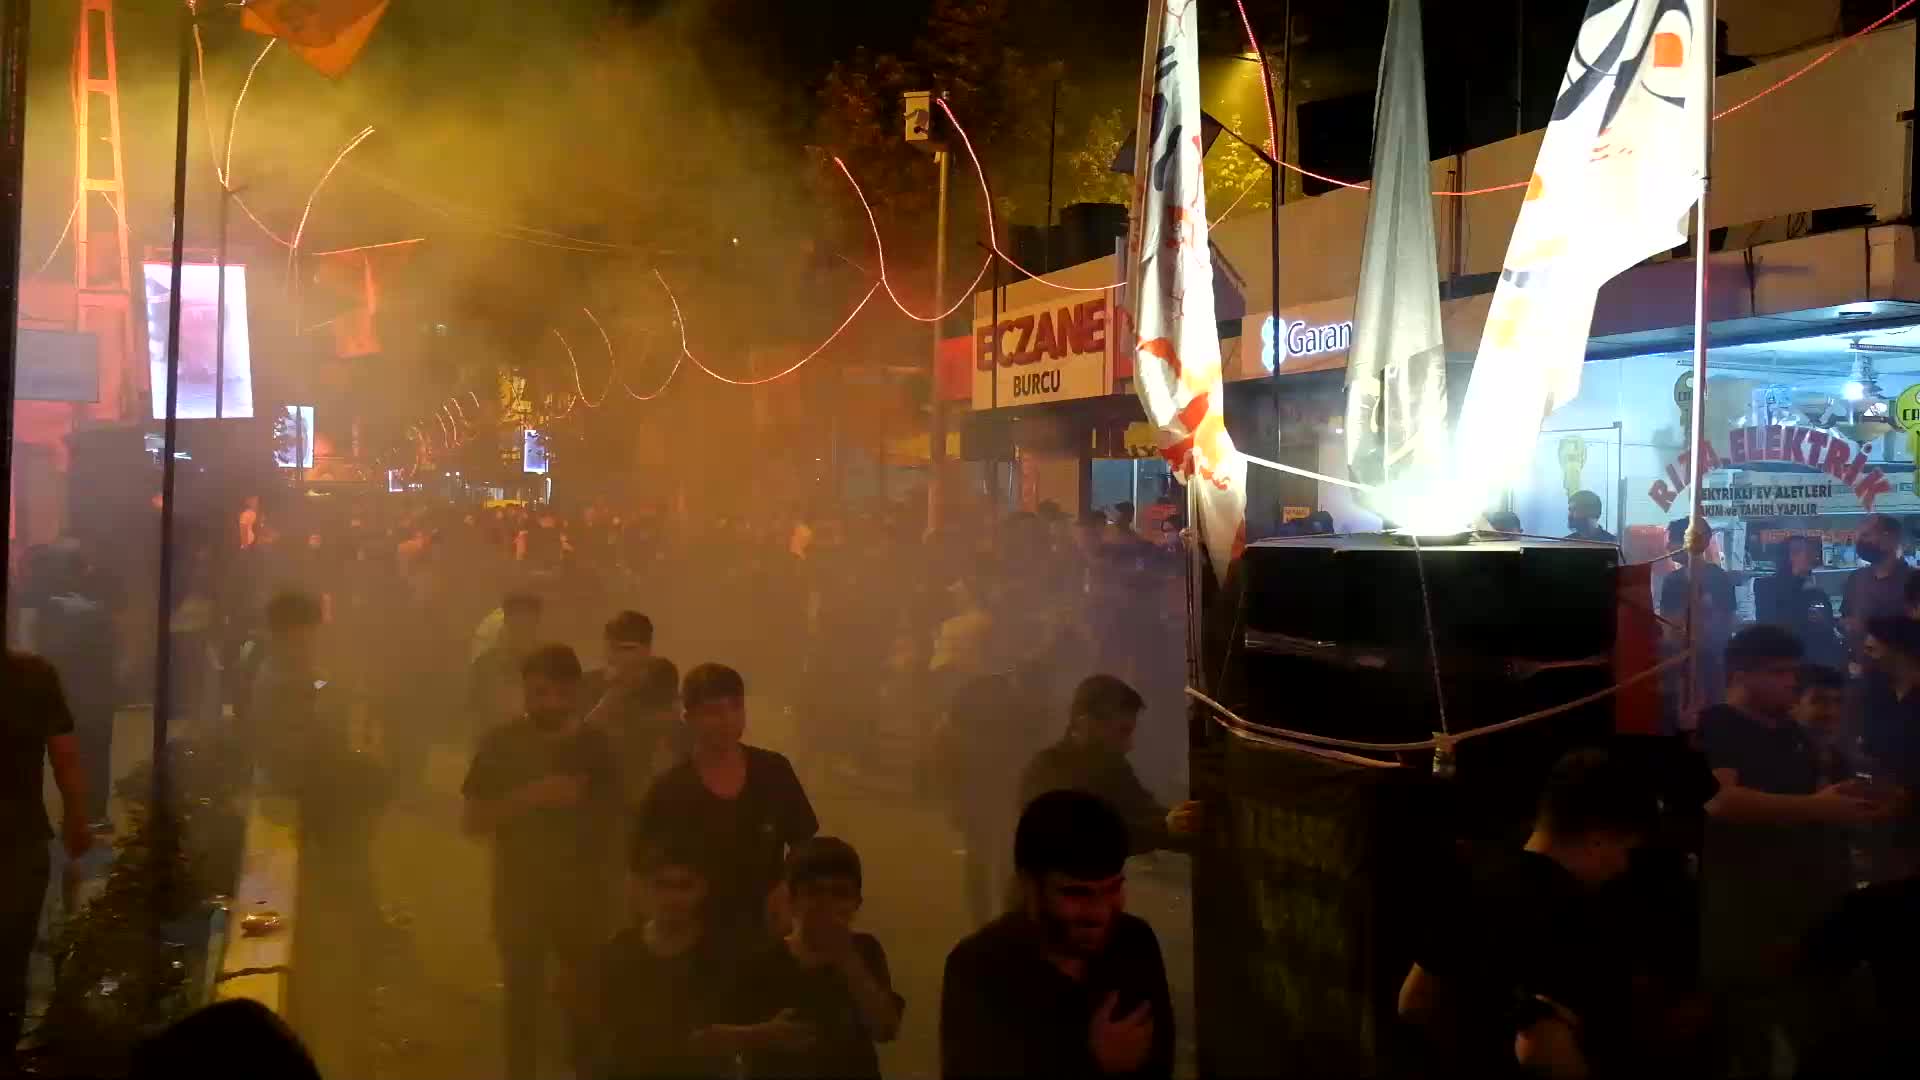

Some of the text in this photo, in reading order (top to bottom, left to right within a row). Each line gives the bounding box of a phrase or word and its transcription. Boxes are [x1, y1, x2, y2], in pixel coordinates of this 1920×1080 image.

[977, 298, 1105, 371] ECZANE
[1287, 321, 1353, 355] Garan
[1013, 369, 1061, 397] BURCU
